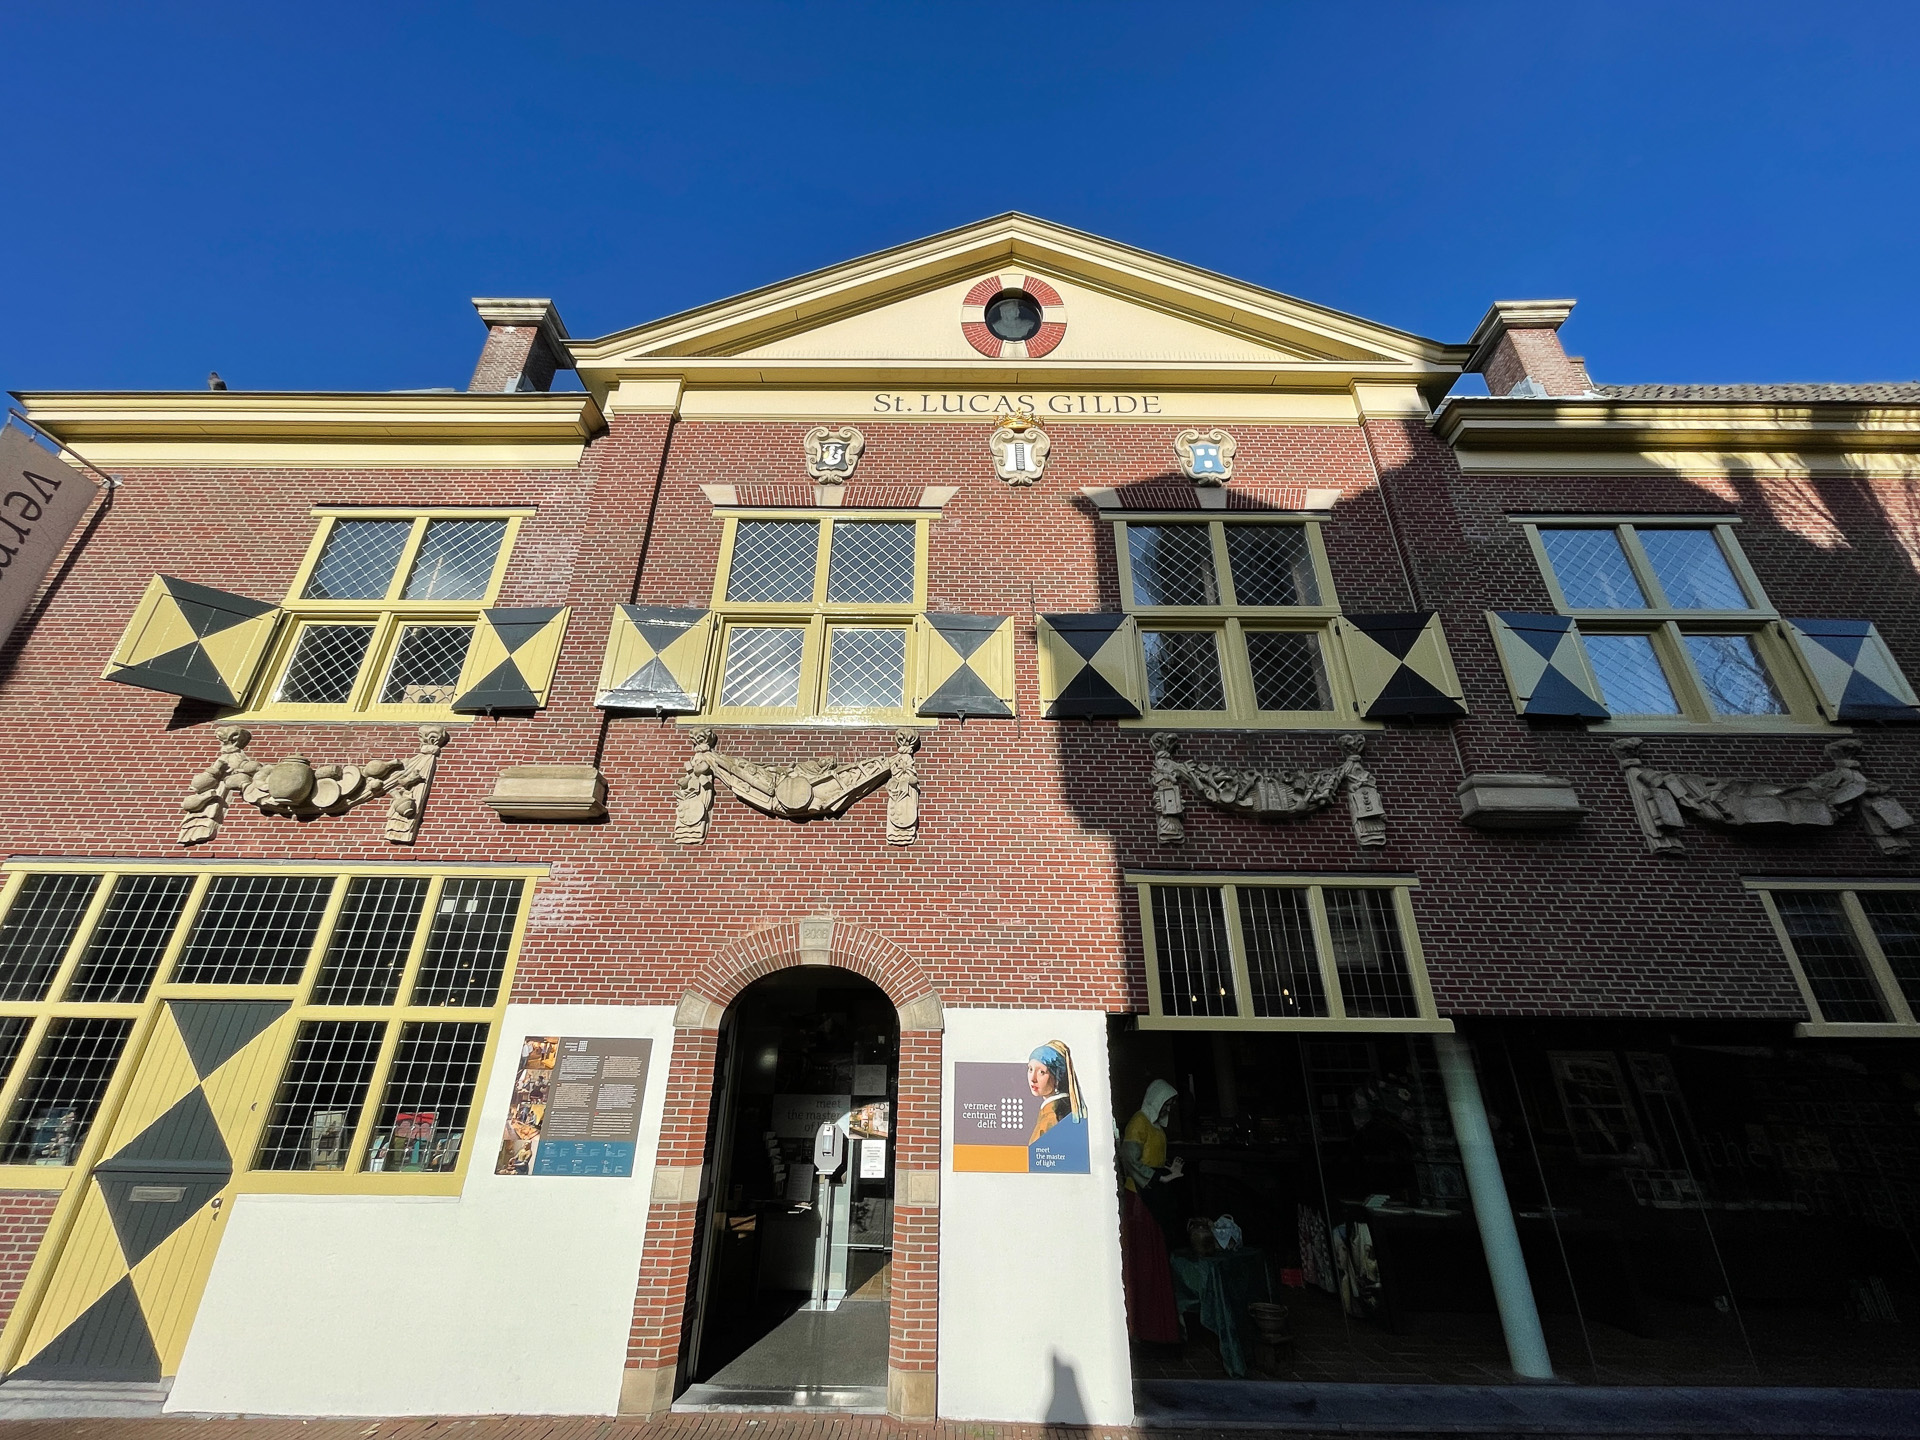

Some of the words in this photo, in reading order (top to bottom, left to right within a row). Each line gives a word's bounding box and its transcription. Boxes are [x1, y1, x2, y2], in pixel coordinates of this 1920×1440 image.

[873, 393, 912, 413] St.
[920, 393, 1036, 414] LUCAS
[1048, 394, 1162, 414] GILDE
[816, 1099, 842, 1109] meet
[963, 1102, 997, 1111] vermeer
[787, 1108, 803, 1120] the
[806, 1109, 841, 1120] master
[962, 1111, 997, 1120] centrum
[977, 1120, 997, 1129] delft
[1042, 1159, 1056, 1168] light
